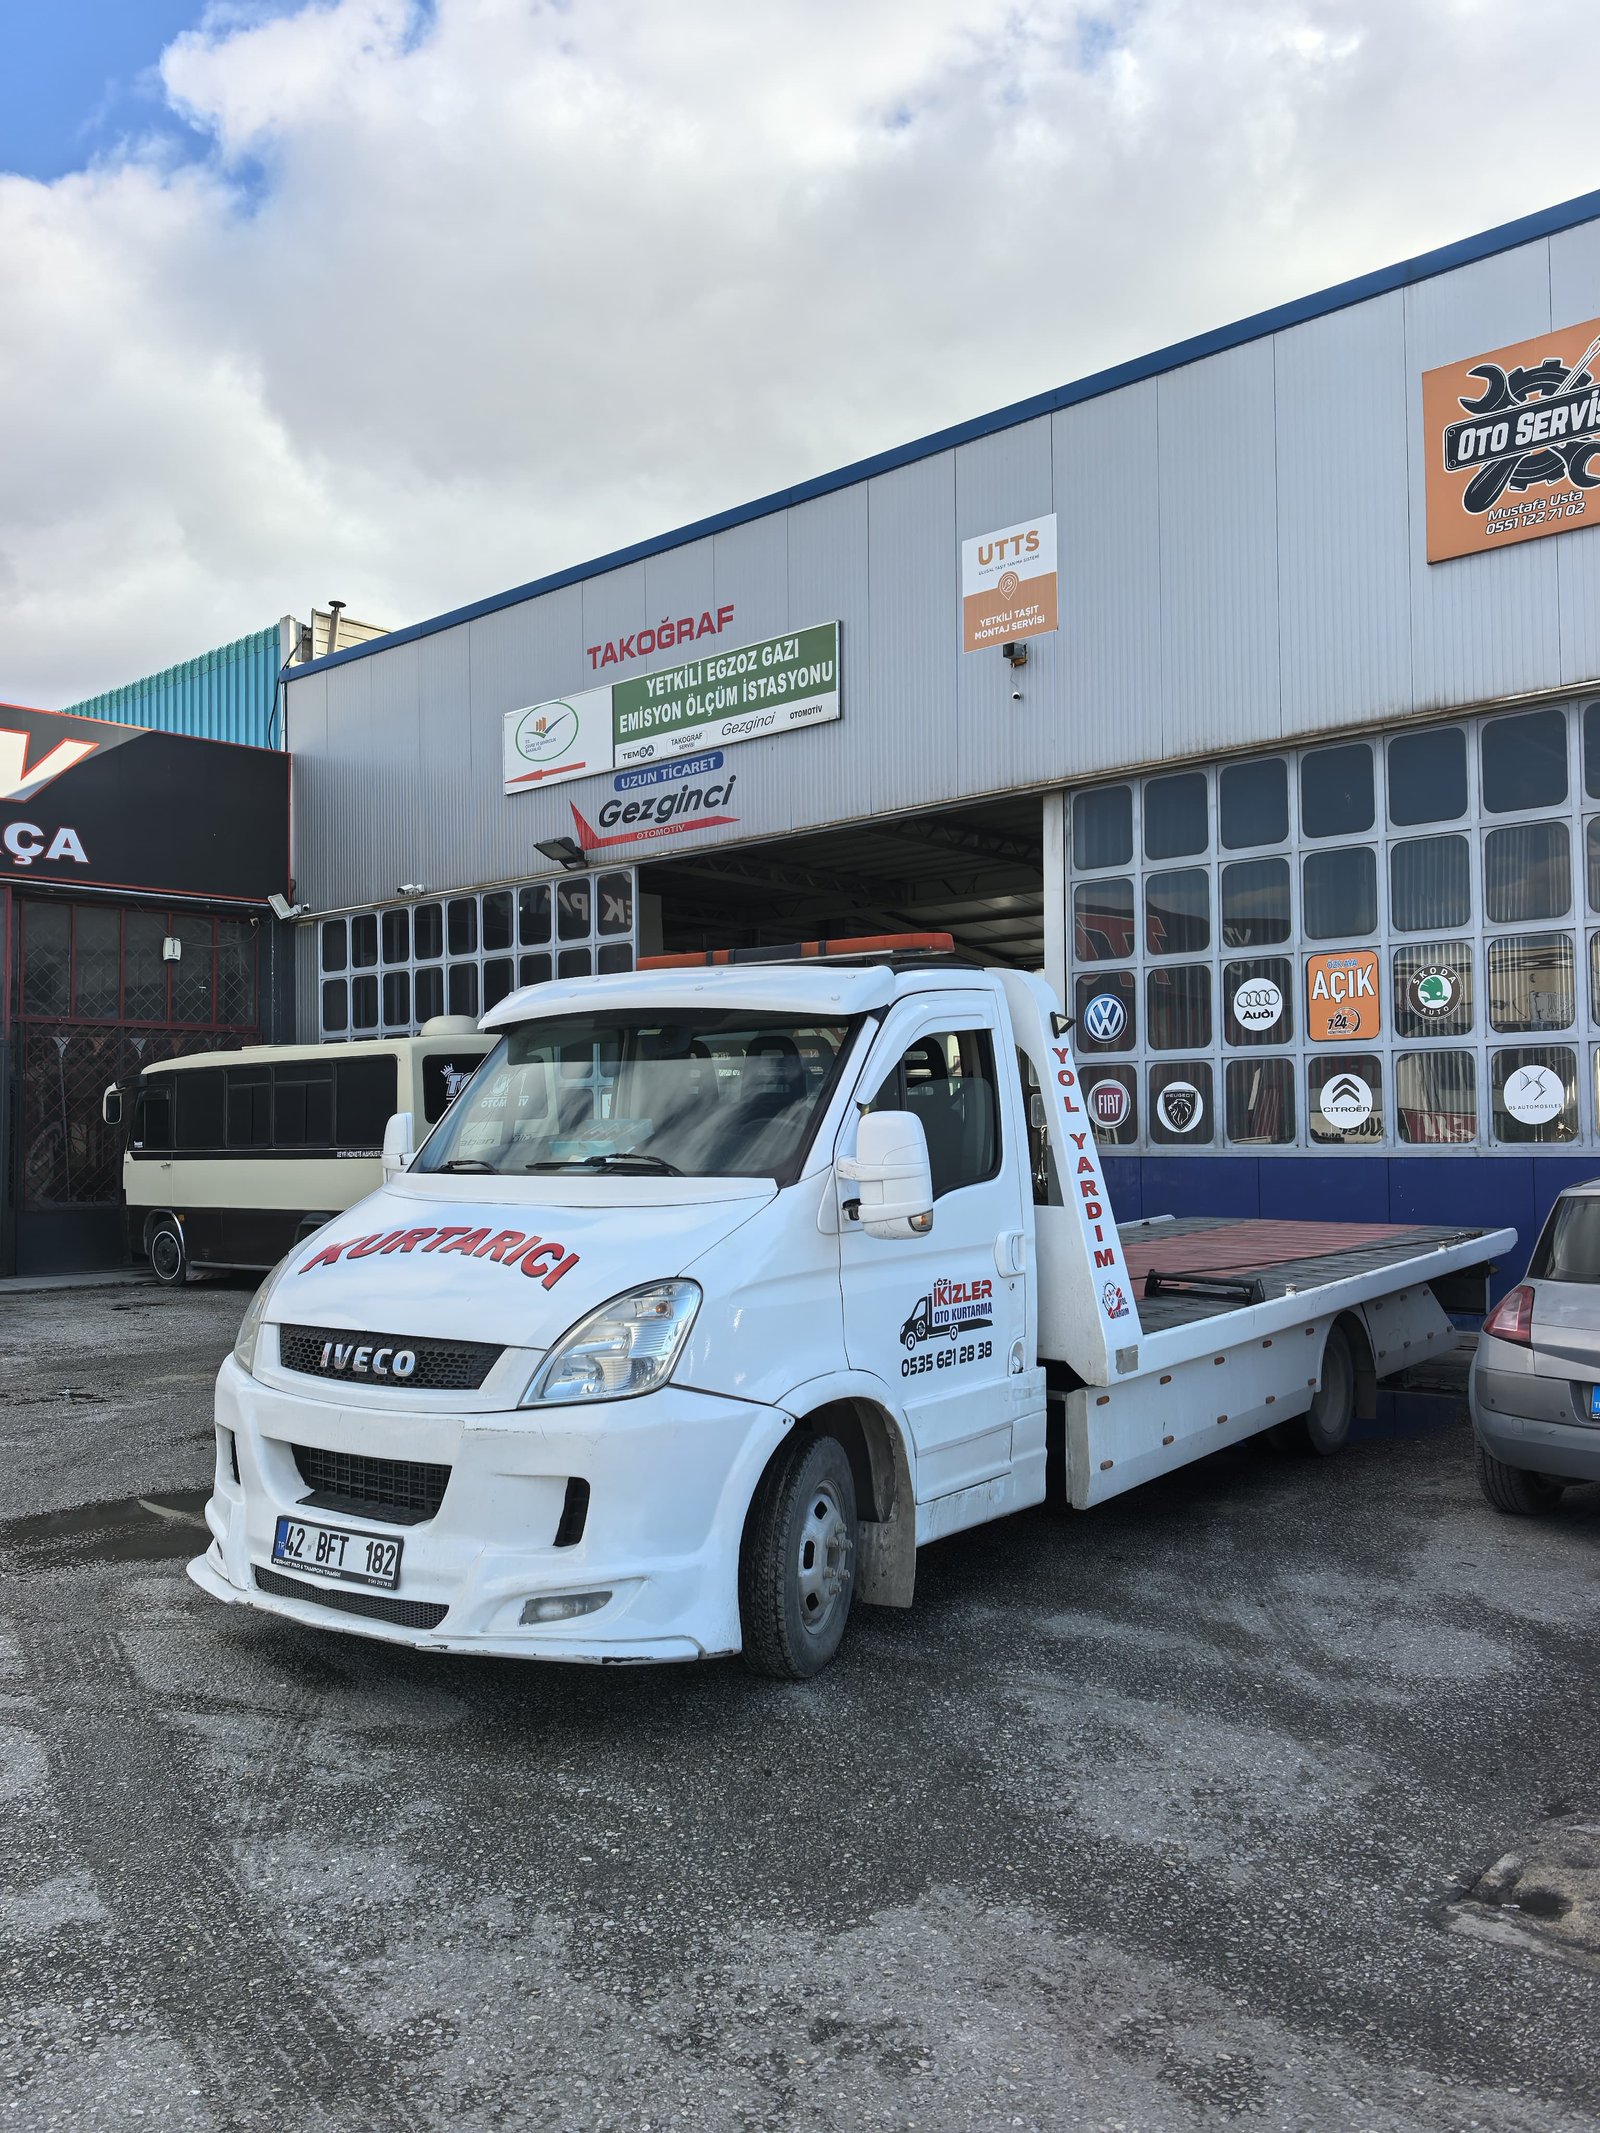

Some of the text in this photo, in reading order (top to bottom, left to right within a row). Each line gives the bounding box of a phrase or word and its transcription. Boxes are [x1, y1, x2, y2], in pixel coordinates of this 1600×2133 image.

[1457, 389, 1600, 461] OTO SERVİ
[1485, 502, 1586, 535] 0551 122 71 02
[1487, 490, 1584, 521] Mustafa Usta
[978, 530, 1040, 566] UTTS
[974, 614, 1045, 640] MONTAJ SERVİSİ
[980, 605, 1039, 627] YETKİLİ TAŞIT
[587, 604, 735, 670] TAKOĞRAF
[646, 638, 799, 698] YETKİLİ EGZOZ GAZI
[619, 660, 833, 734] EMİSYON ÖLÇÜM İSTASYONU
[721, 705, 823, 736] Gezginci OTOMOTİV
[622, 744, 655, 760] TEMSA
[621, 757, 716, 789] UZUN TİCARET
[598, 774, 737, 828] Gezginci
[0, 821, 91, 866] ÇA
[636, 823, 685, 840] OTOMOTİV
[1311, 963, 1376, 1004] AÇIK
[1242, 1008, 1274, 1021] Audi
[1420, 1005, 1449, 1016] AUTO
[1098, 1094, 1121, 1115] FIAT
[1052, 1047, 1116, 1269] YOL YARDIM
[297, 1226, 581, 1292] KURTARICI
[933, 1279, 993, 1308] İKİZLER
[937, 1278, 949, 1286] ÖZ
[934, 1302, 993, 1325] OTO KURTARMA
[319, 1342, 417, 1378] IVECO
[901, 1340, 993, 1377] 0535 621 28 38
[277, 1525, 397, 1577] TR 42 BFT 182
